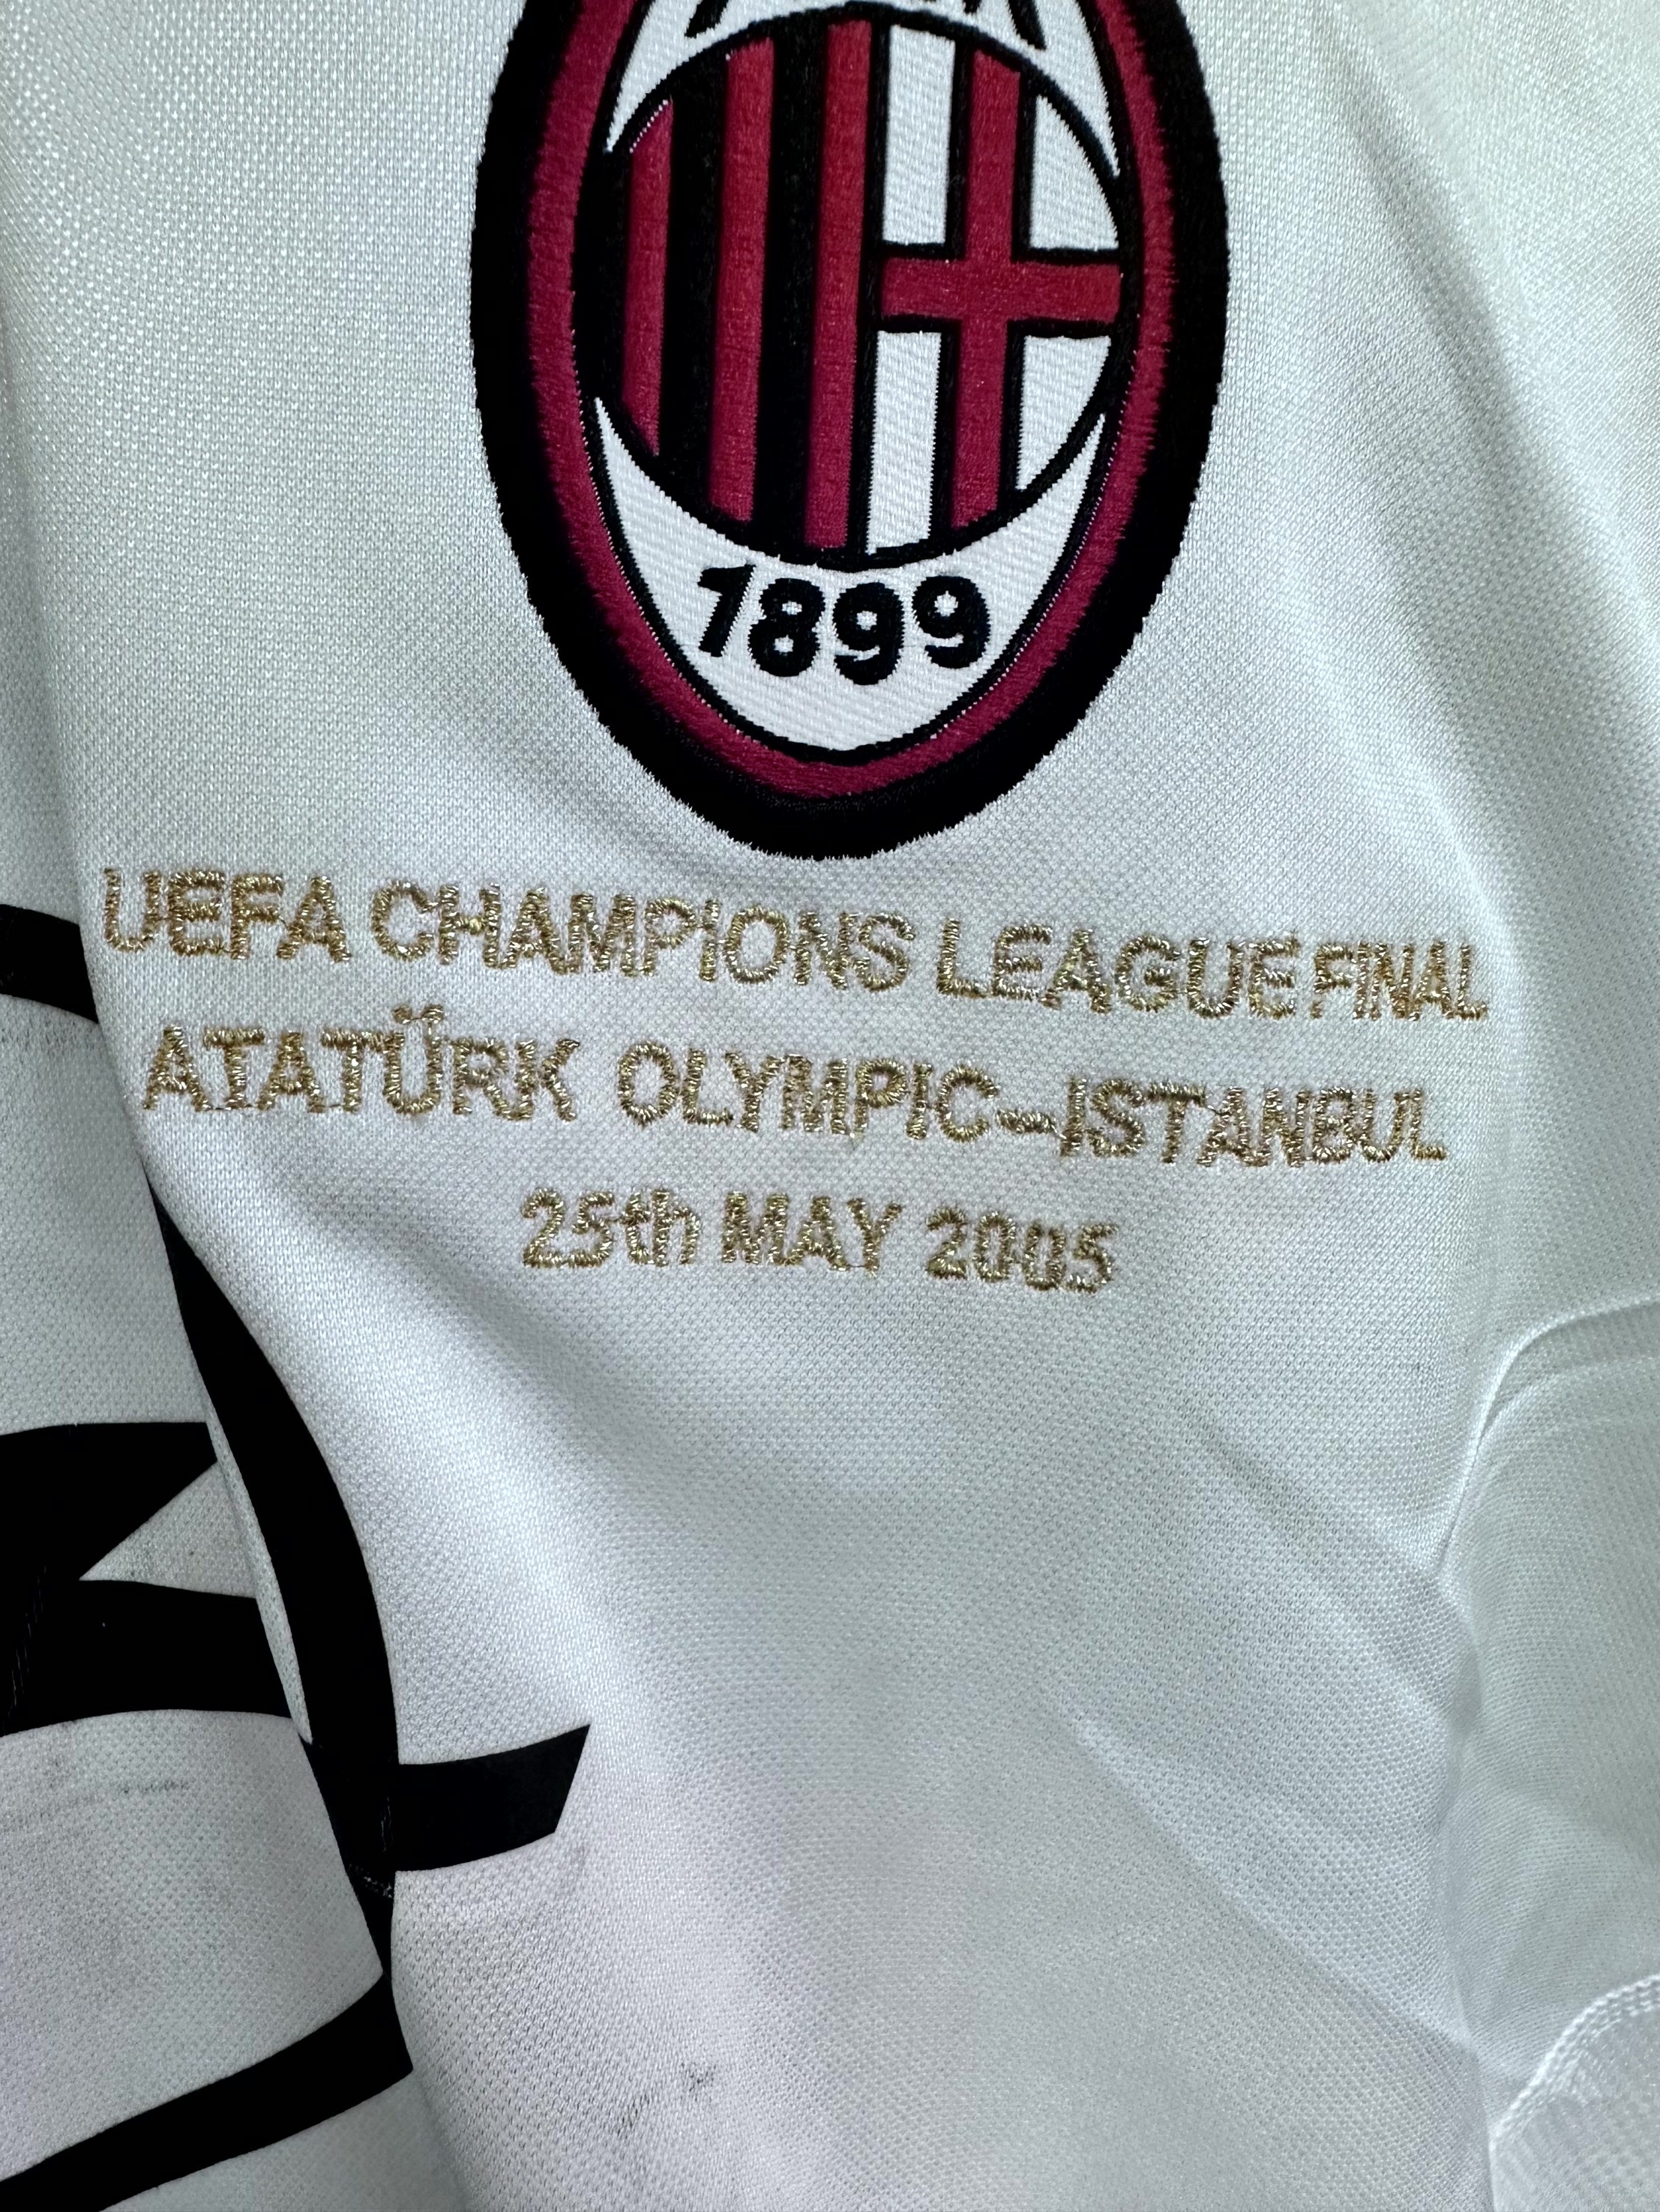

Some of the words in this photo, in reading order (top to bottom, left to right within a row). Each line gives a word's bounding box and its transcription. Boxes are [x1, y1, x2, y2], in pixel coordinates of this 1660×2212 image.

[698, 564, 990, 685] 1899
[103, 867, 351, 963] UEFA
[370, 879, 915, 992] CHAMPIONS
[936, 917, 1299, 1019] LEAGUE
[1310, 939, 1488, 1022] FINAL
[142, 1003, 581, 1123] ATATÜRK
[520, 1187, 700, 1270] 25th
[721, 1190, 902, 1277] MAY
[924, 1205, 1121, 1295] 2005
